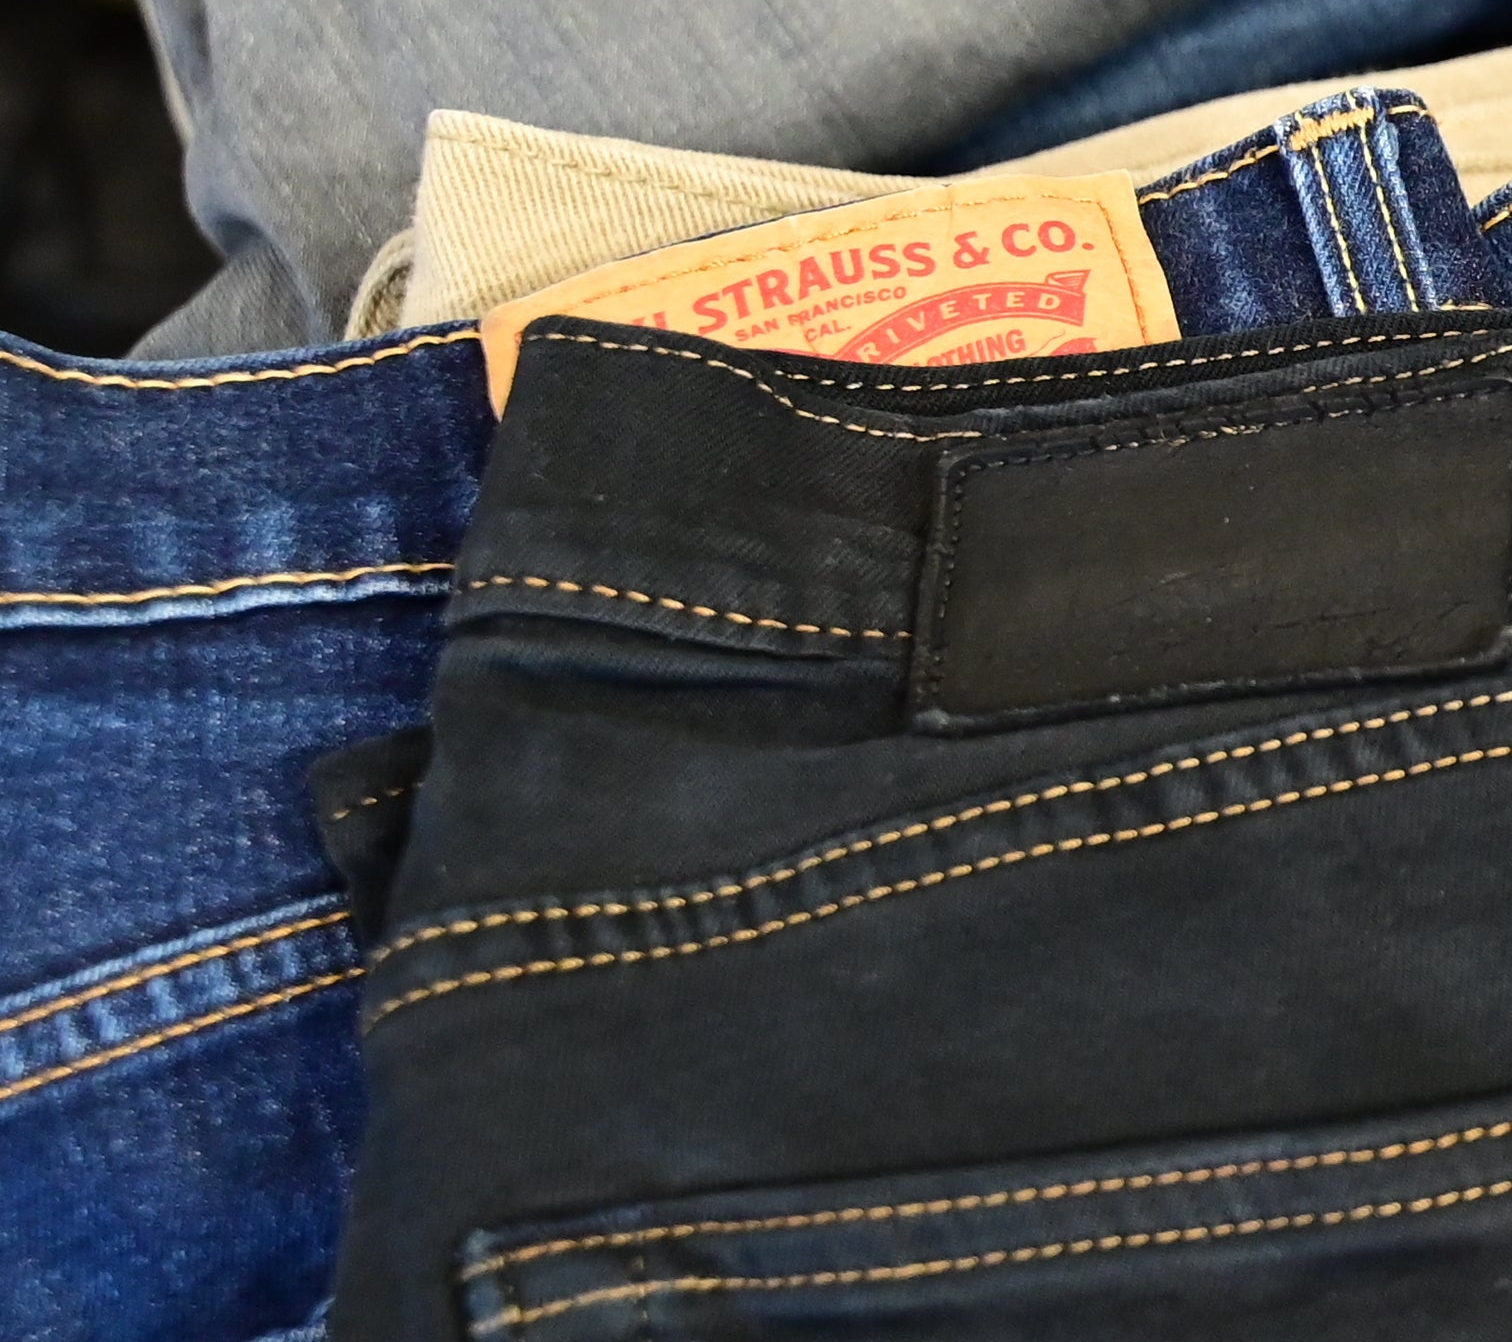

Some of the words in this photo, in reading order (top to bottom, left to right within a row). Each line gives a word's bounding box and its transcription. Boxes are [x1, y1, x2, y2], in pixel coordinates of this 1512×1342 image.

[691, 241, 935, 334] STRAUSS
[951, 231, 989, 268] &
[1001, 220, 1094, 258] CO.
[735, 318, 780, 342] SAN
[787, 286, 907, 326] FRANCISCO
[803, 319, 852, 343] CAL.
[856, 291, 1062, 363] RIVETED
